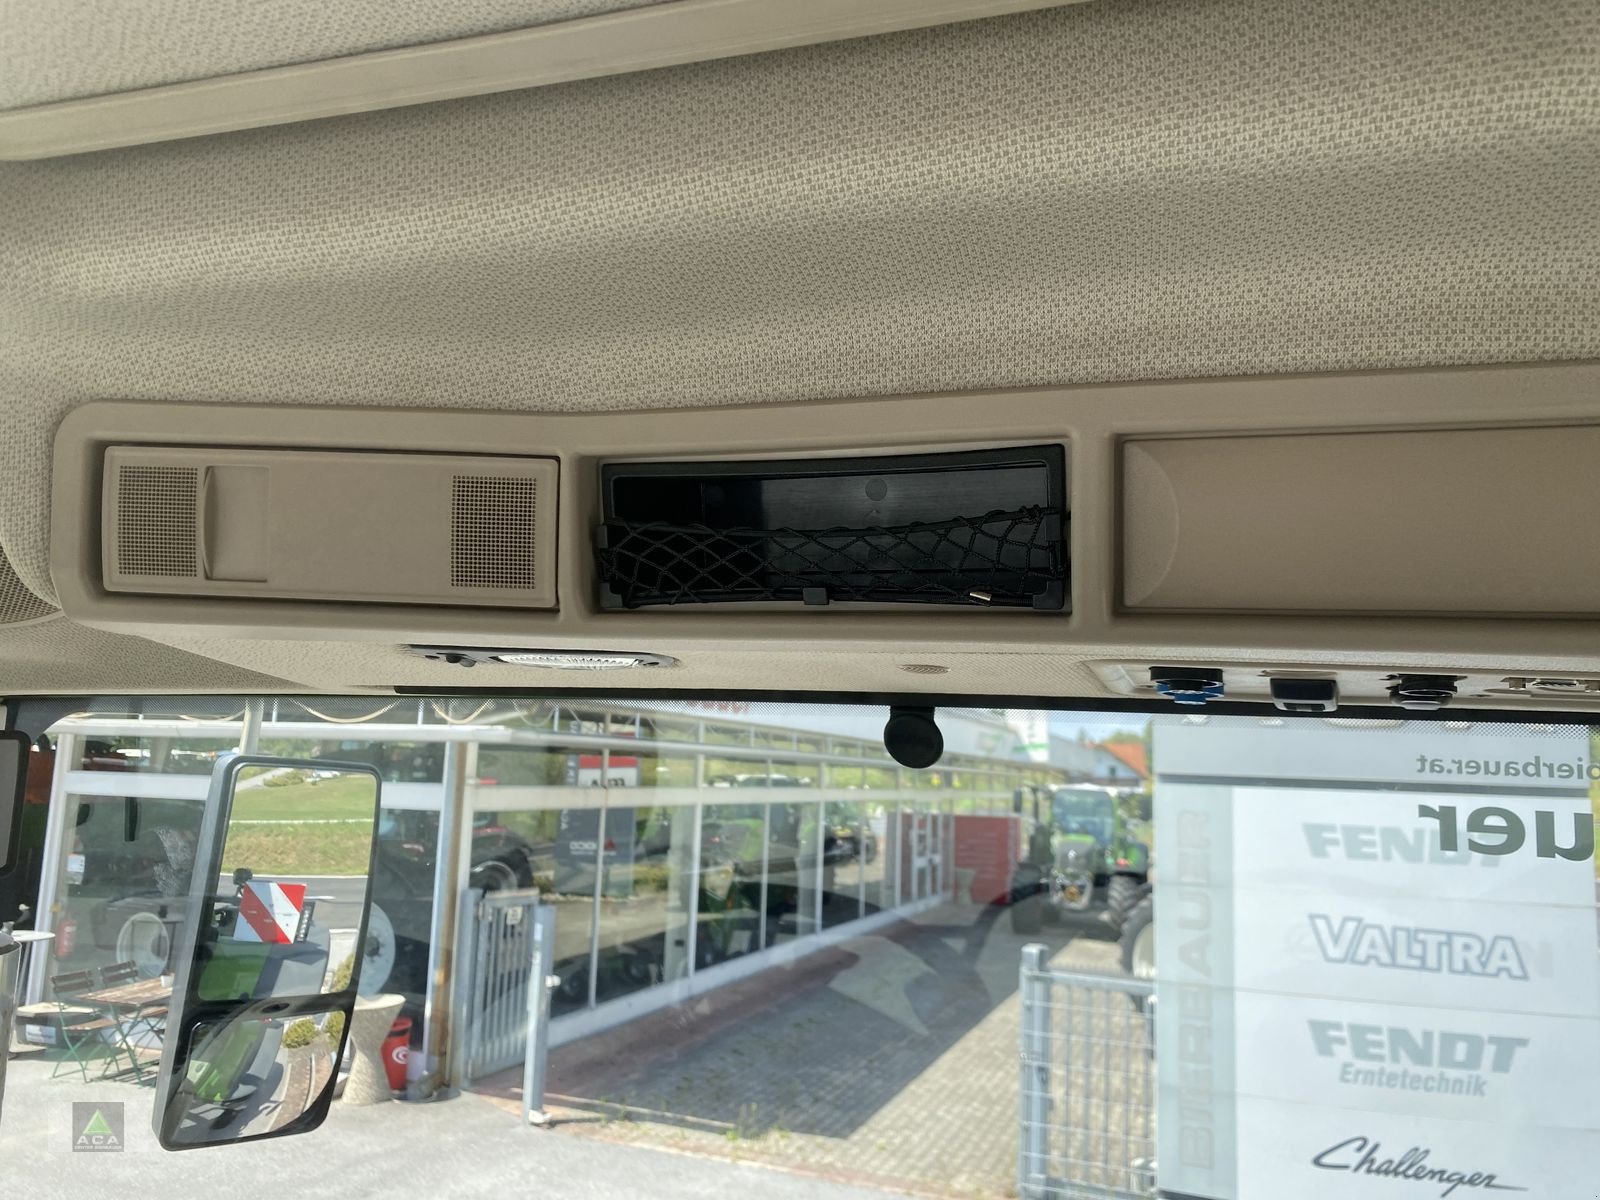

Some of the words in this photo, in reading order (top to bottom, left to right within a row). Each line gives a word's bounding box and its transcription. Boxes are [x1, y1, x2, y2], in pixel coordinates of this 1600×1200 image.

[1308, 913, 1529, 980] VALTRA
[1307, 1019, 1531, 1074] FENDT
[1339, 1061, 1488, 1097] Erntetechnik
[1312, 1136, 1529, 1198] Challenger
